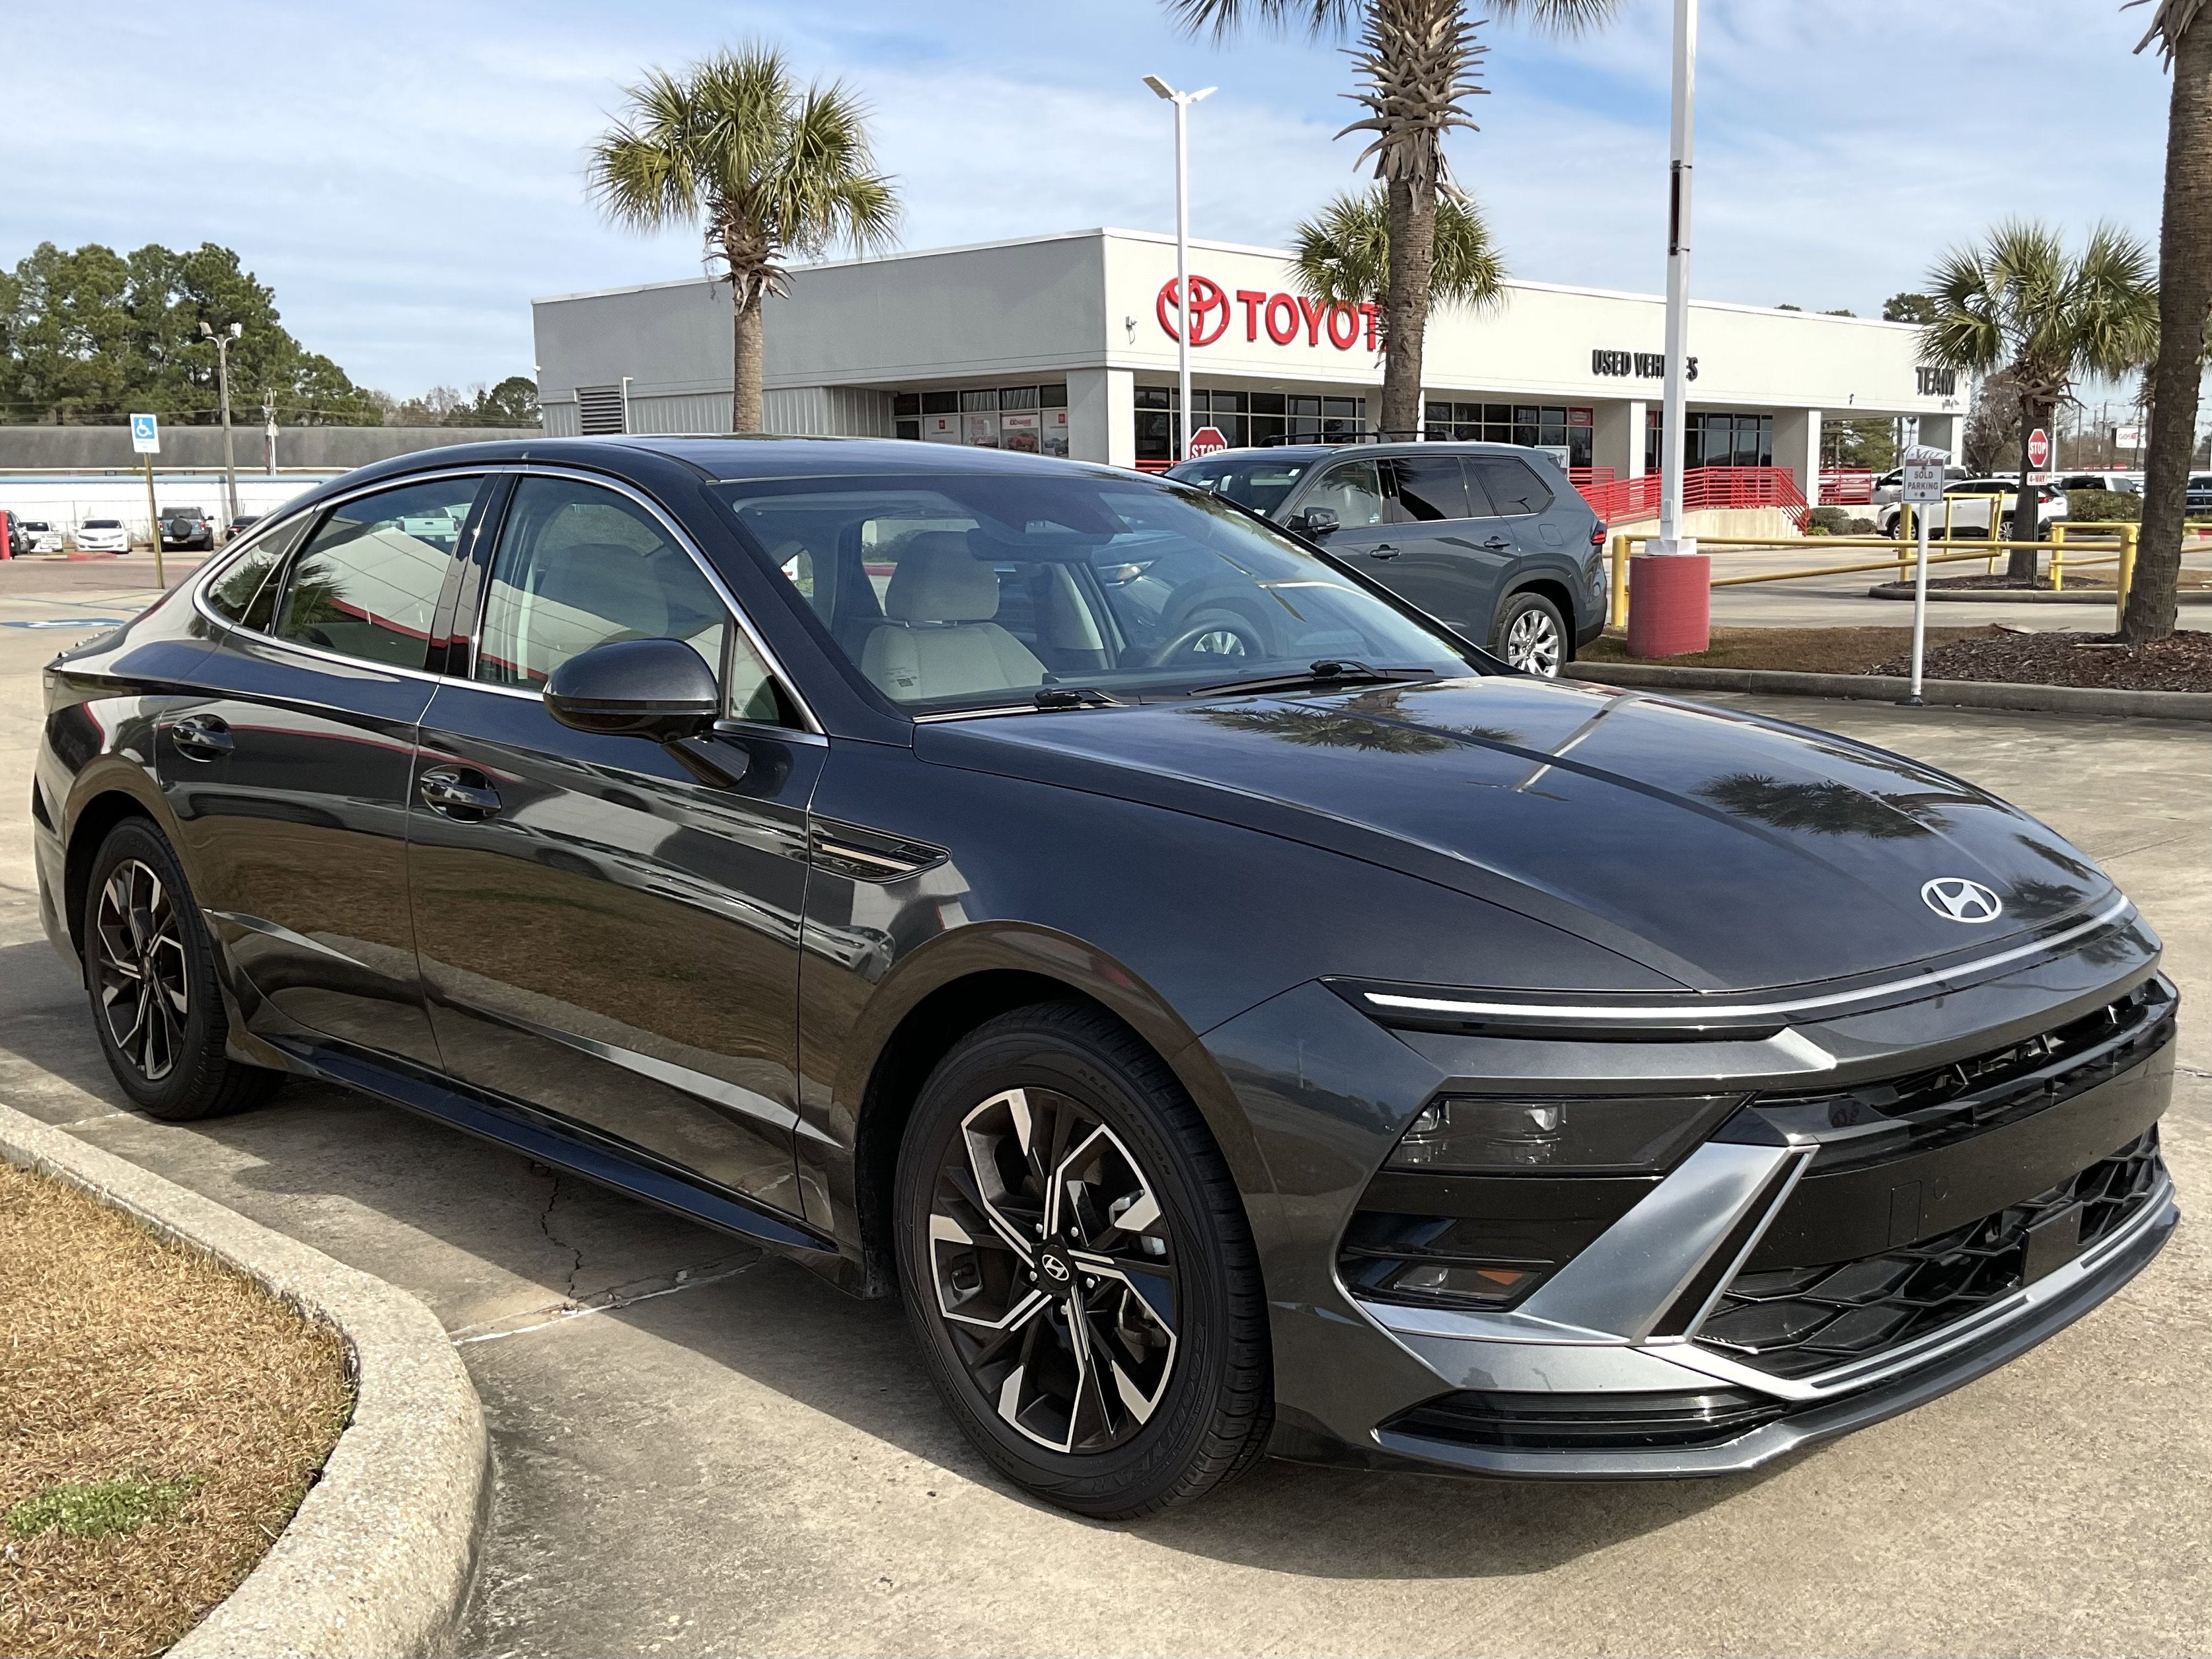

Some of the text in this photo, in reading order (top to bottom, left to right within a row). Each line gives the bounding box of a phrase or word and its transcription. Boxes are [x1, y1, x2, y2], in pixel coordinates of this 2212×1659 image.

[1237, 289, 1387, 352] TOYOT
[1592, 349, 1698, 381] USED VEHS
[1915, 366, 1956, 396] TEAM
[2030, 441, 2046, 455] STOP
[1907, 482, 1938, 490] PARKING
